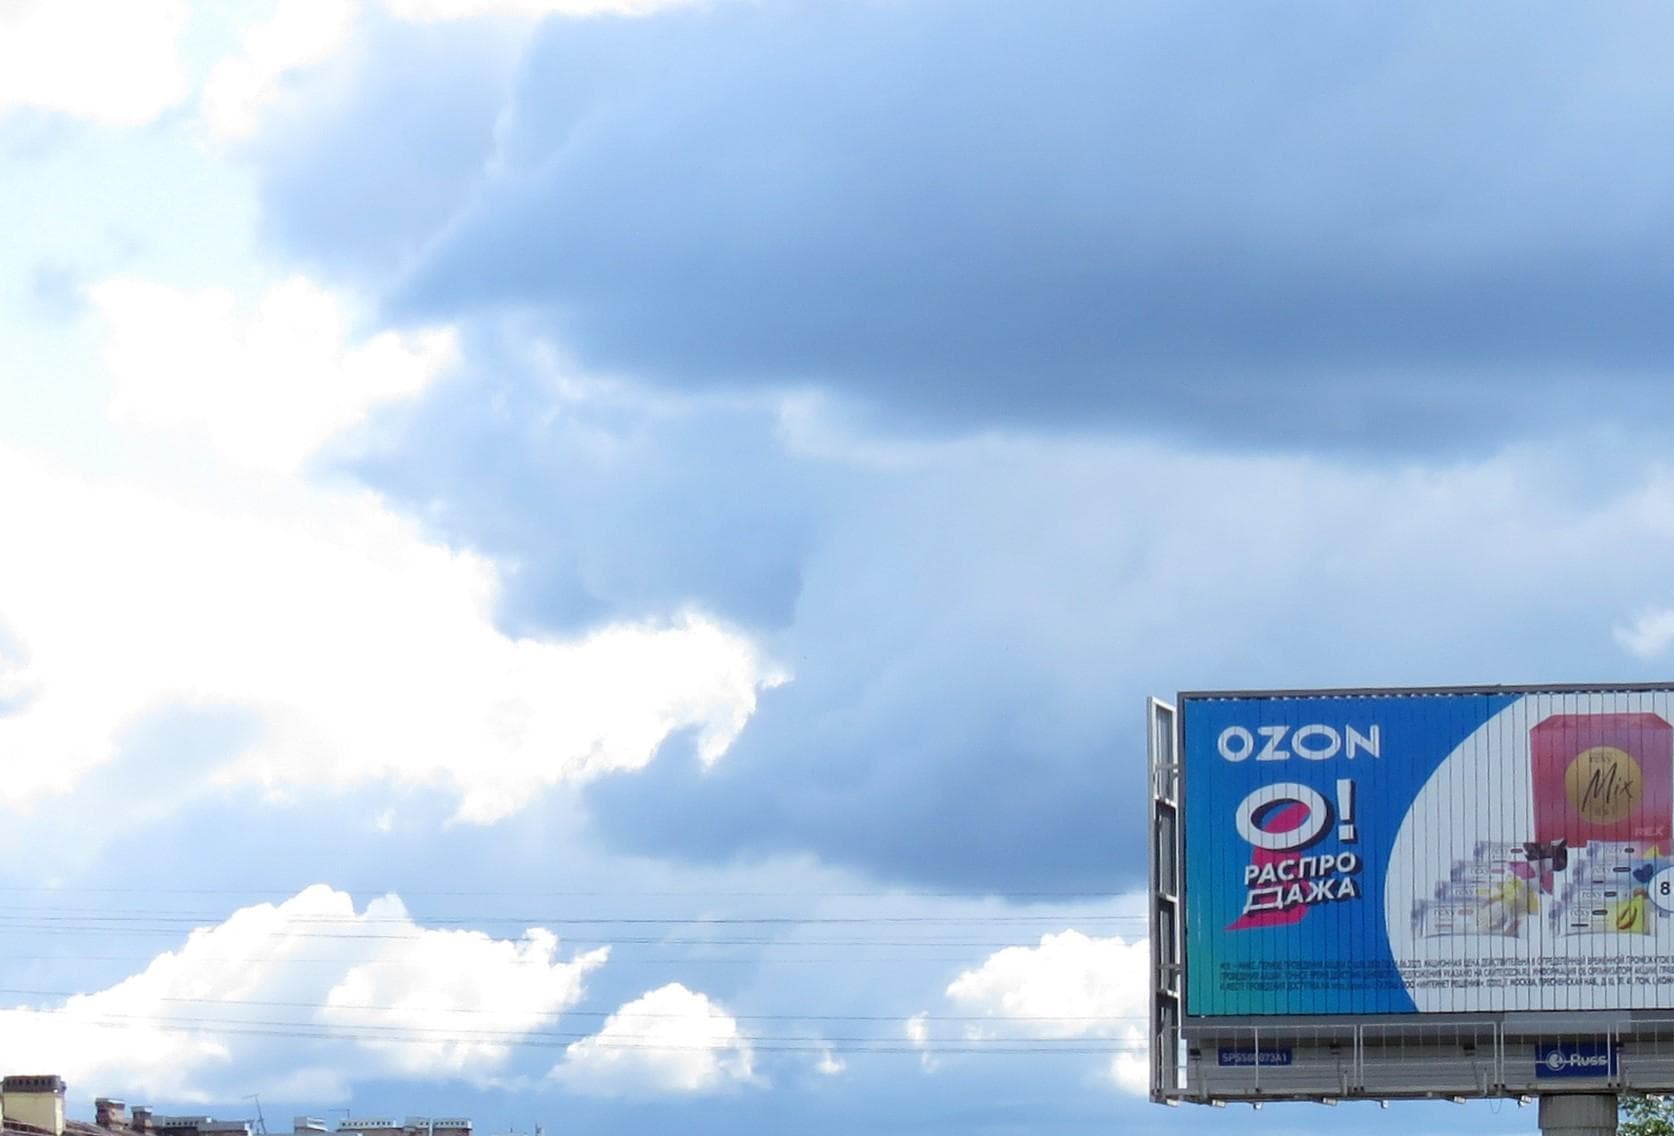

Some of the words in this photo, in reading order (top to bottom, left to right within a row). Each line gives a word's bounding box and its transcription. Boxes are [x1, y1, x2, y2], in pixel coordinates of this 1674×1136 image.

[1217, 724, 1380, 762] OZON
[1582, 762, 1633, 812] Mix
[1244, 851, 1357, 886] РАСПРО
[1242, 876, 1356, 914] ДАЖА
[1659, 881, 1671, 896] 8
[1569, 1053, 1608, 1067] Russ
